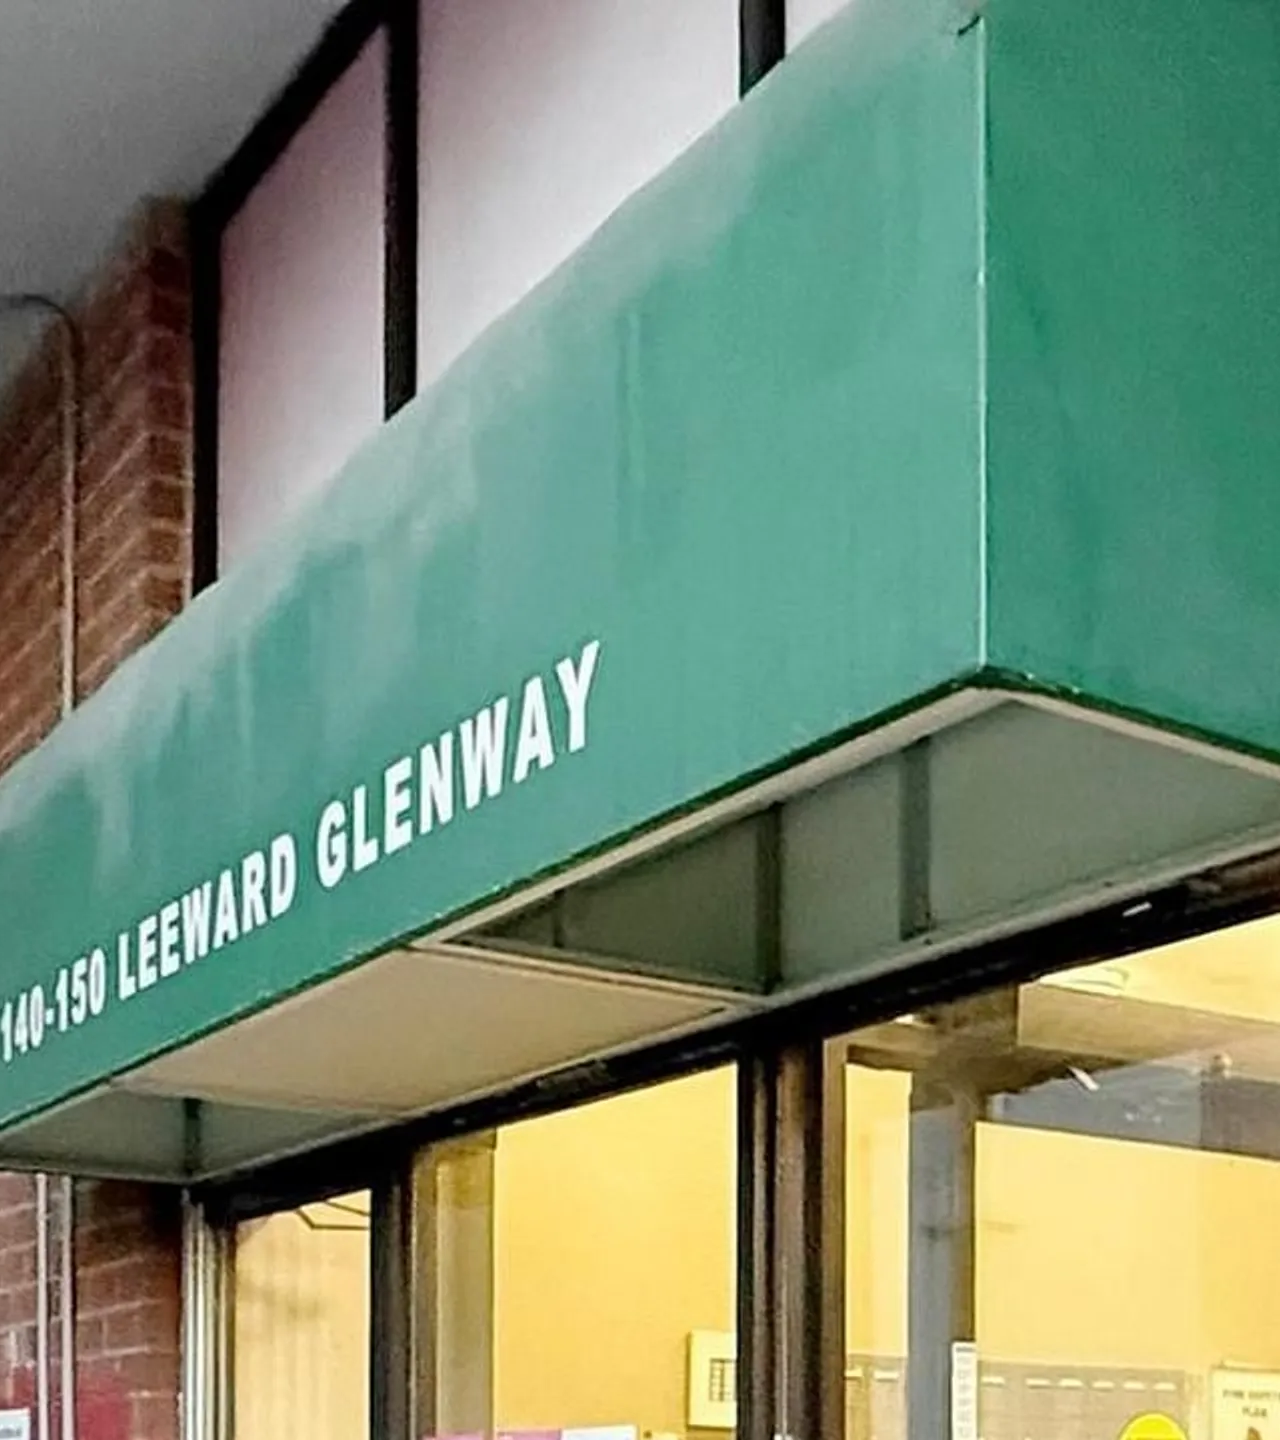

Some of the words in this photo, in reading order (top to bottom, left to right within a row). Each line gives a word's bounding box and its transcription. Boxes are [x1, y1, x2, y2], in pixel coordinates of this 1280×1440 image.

[0, 948, 107, 1063] 140-150
[117, 831, 299, 1001] LEEWARD
[316, 640, 601, 889] GLENWAY
